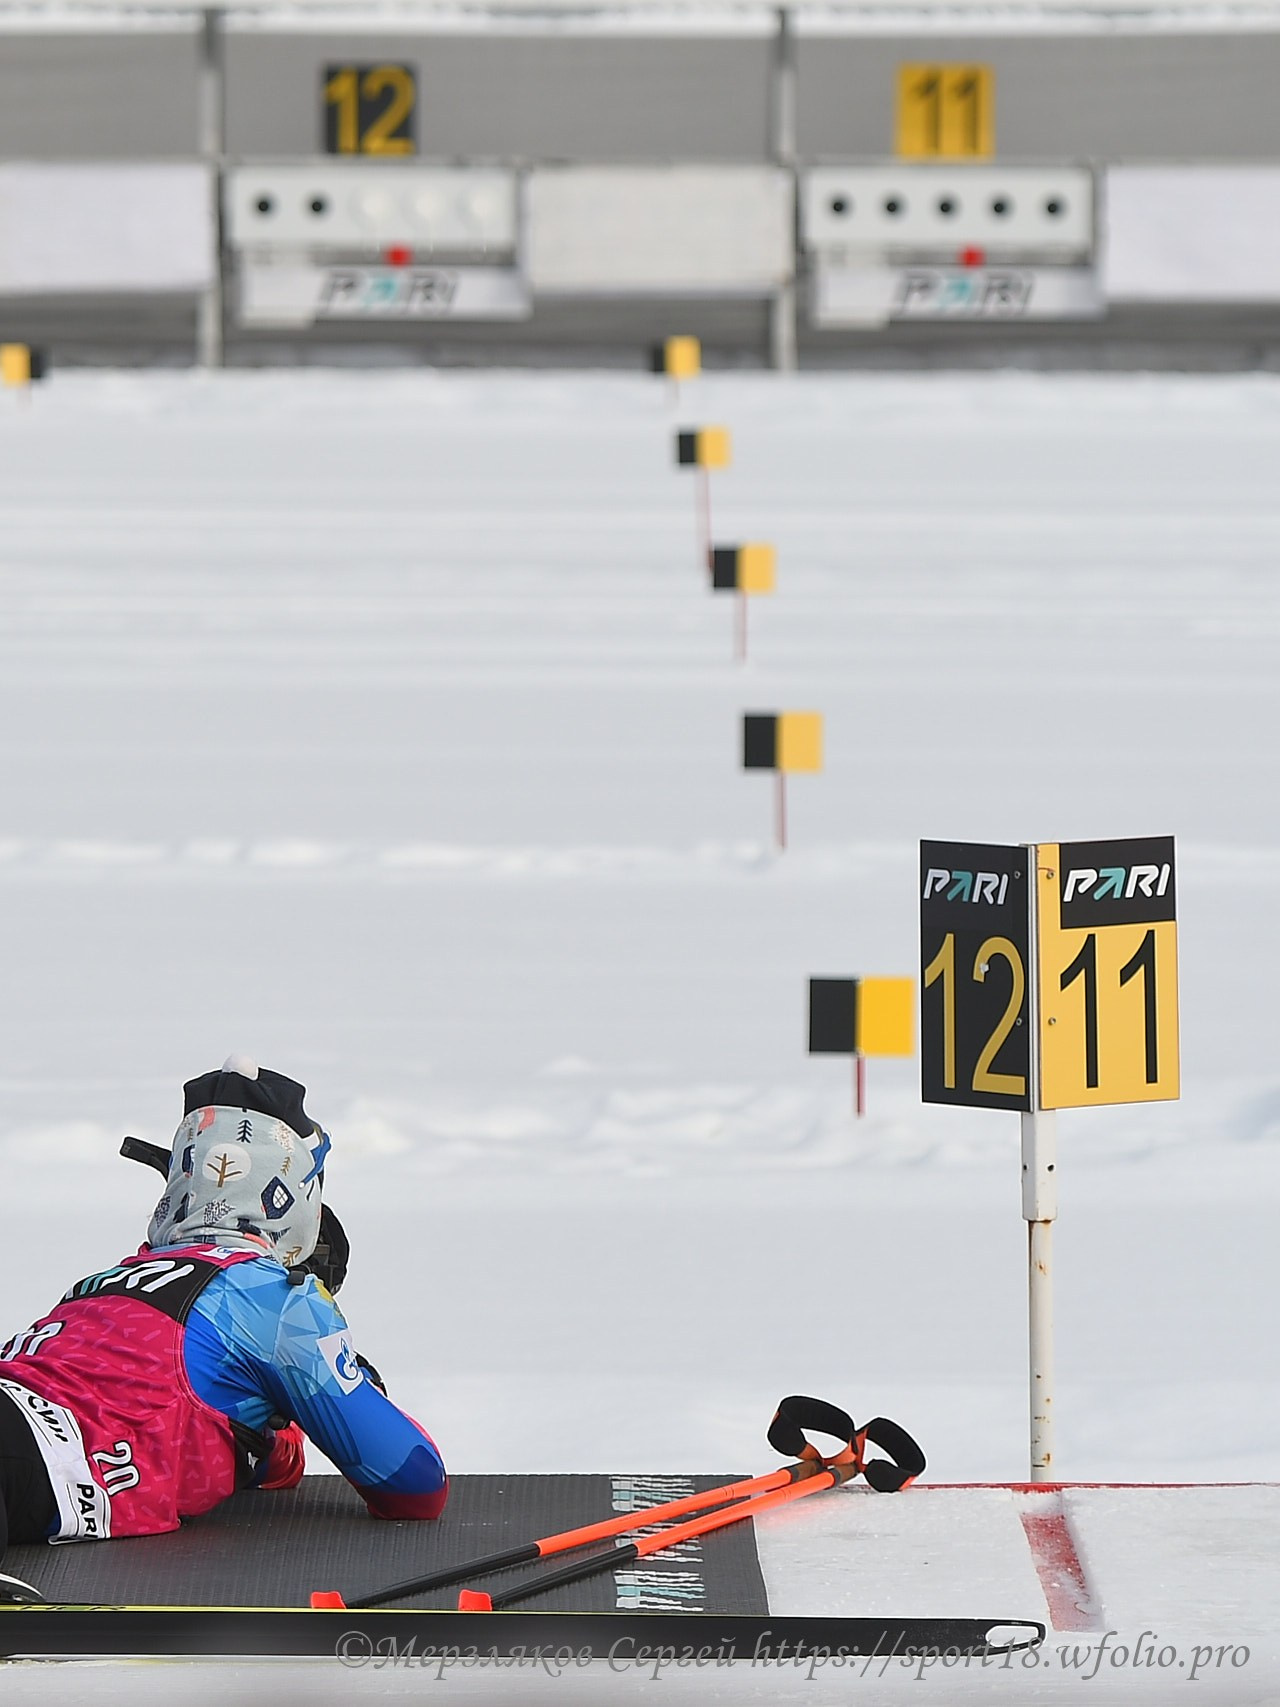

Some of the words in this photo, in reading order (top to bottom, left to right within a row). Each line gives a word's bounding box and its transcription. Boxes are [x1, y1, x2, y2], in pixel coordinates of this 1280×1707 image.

[325, 65, 416, 156] 12
[908, 68, 982, 157] 11
[924, 868, 1009, 905] PARI
[1063, 863, 1171, 903] PARI
[924, 932, 1026, 1096] 12
[1060, 929, 1158, 1089] 11
[91, 1440, 140, 1496] 20
[76, 1483, 98, 1538] PARI
